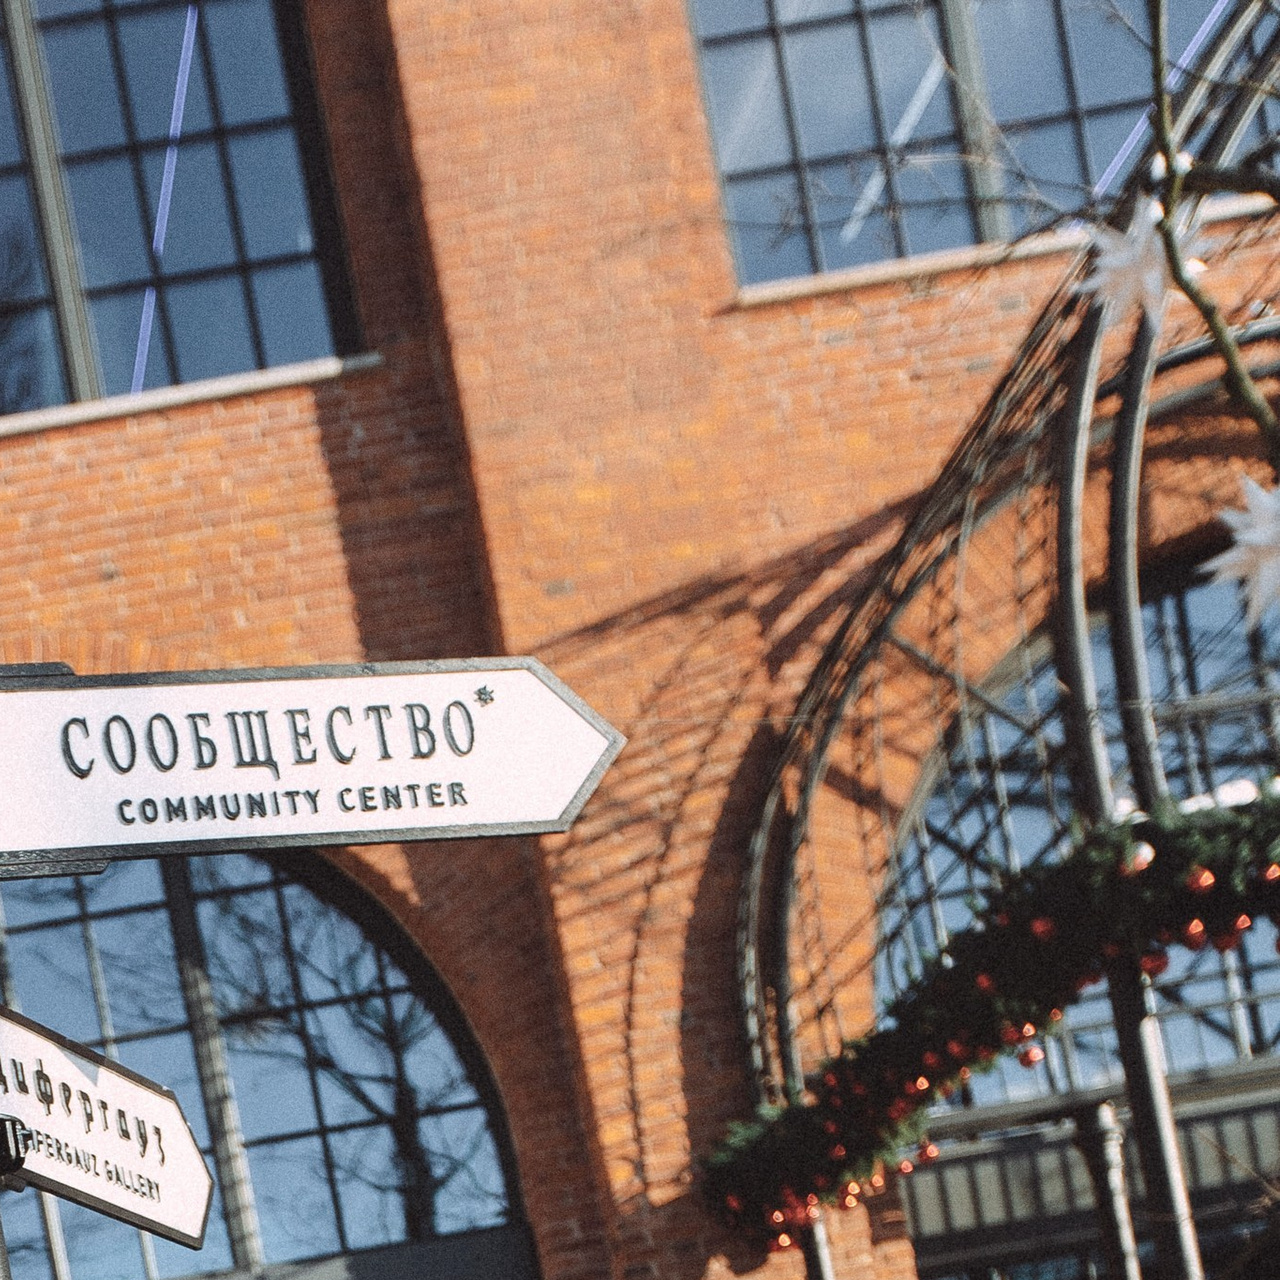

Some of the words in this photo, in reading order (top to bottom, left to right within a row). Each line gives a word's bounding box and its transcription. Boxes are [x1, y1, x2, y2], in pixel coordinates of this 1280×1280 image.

[120, 787, 321, 826] COMMUNITY
[338, 780, 469, 814] CENTER
[104, 1160, 161, 1203] GALLERY
